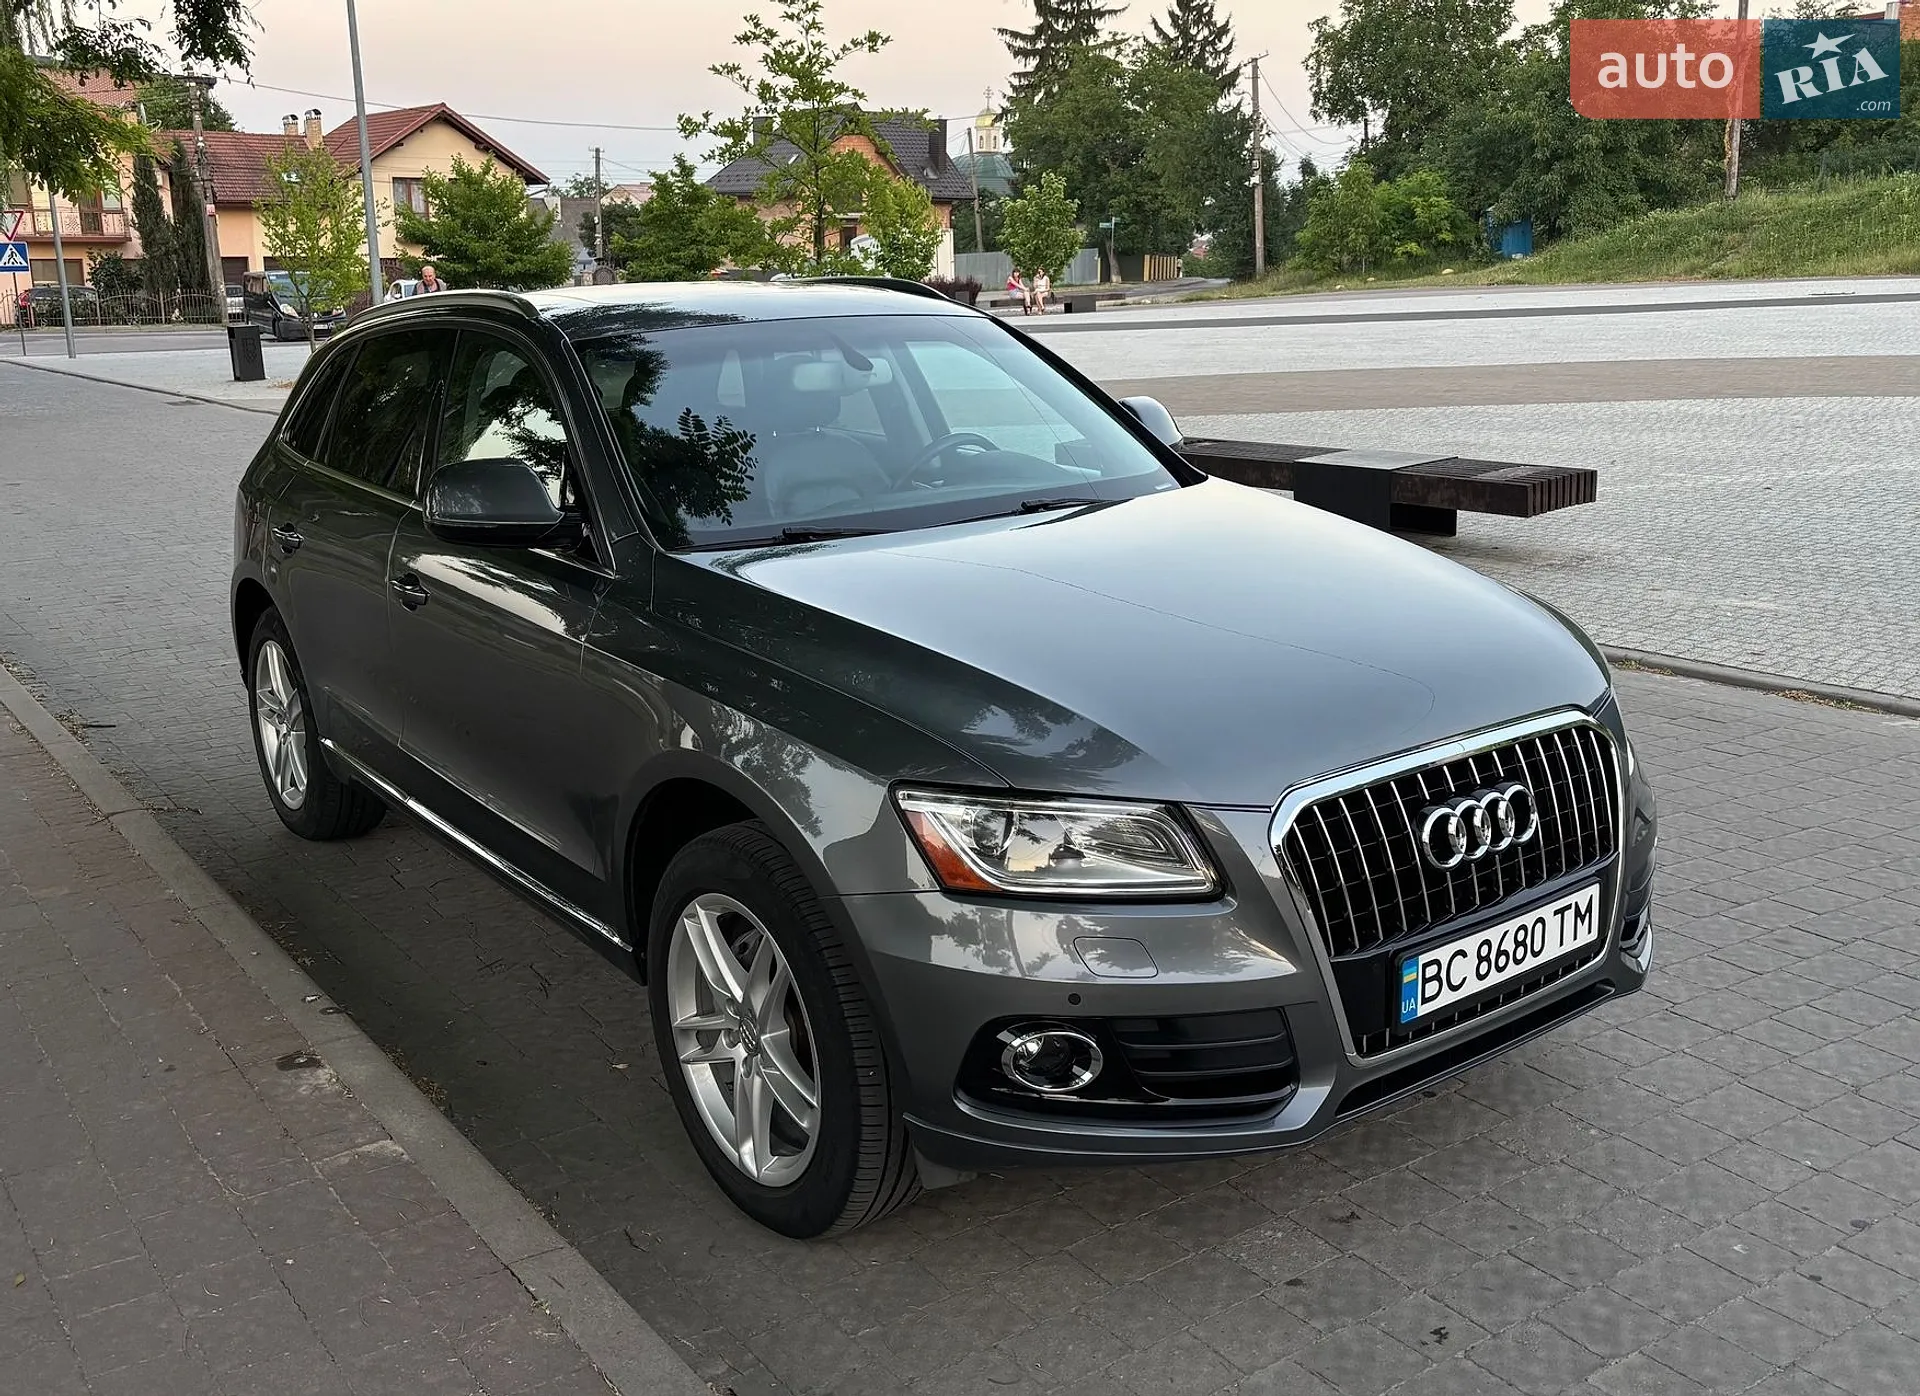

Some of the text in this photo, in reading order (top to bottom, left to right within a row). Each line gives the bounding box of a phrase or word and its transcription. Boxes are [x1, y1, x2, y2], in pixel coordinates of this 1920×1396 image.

[1420, 894, 1594, 1006] BC 8680 TM
[1402, 997, 1416, 1014] UA
